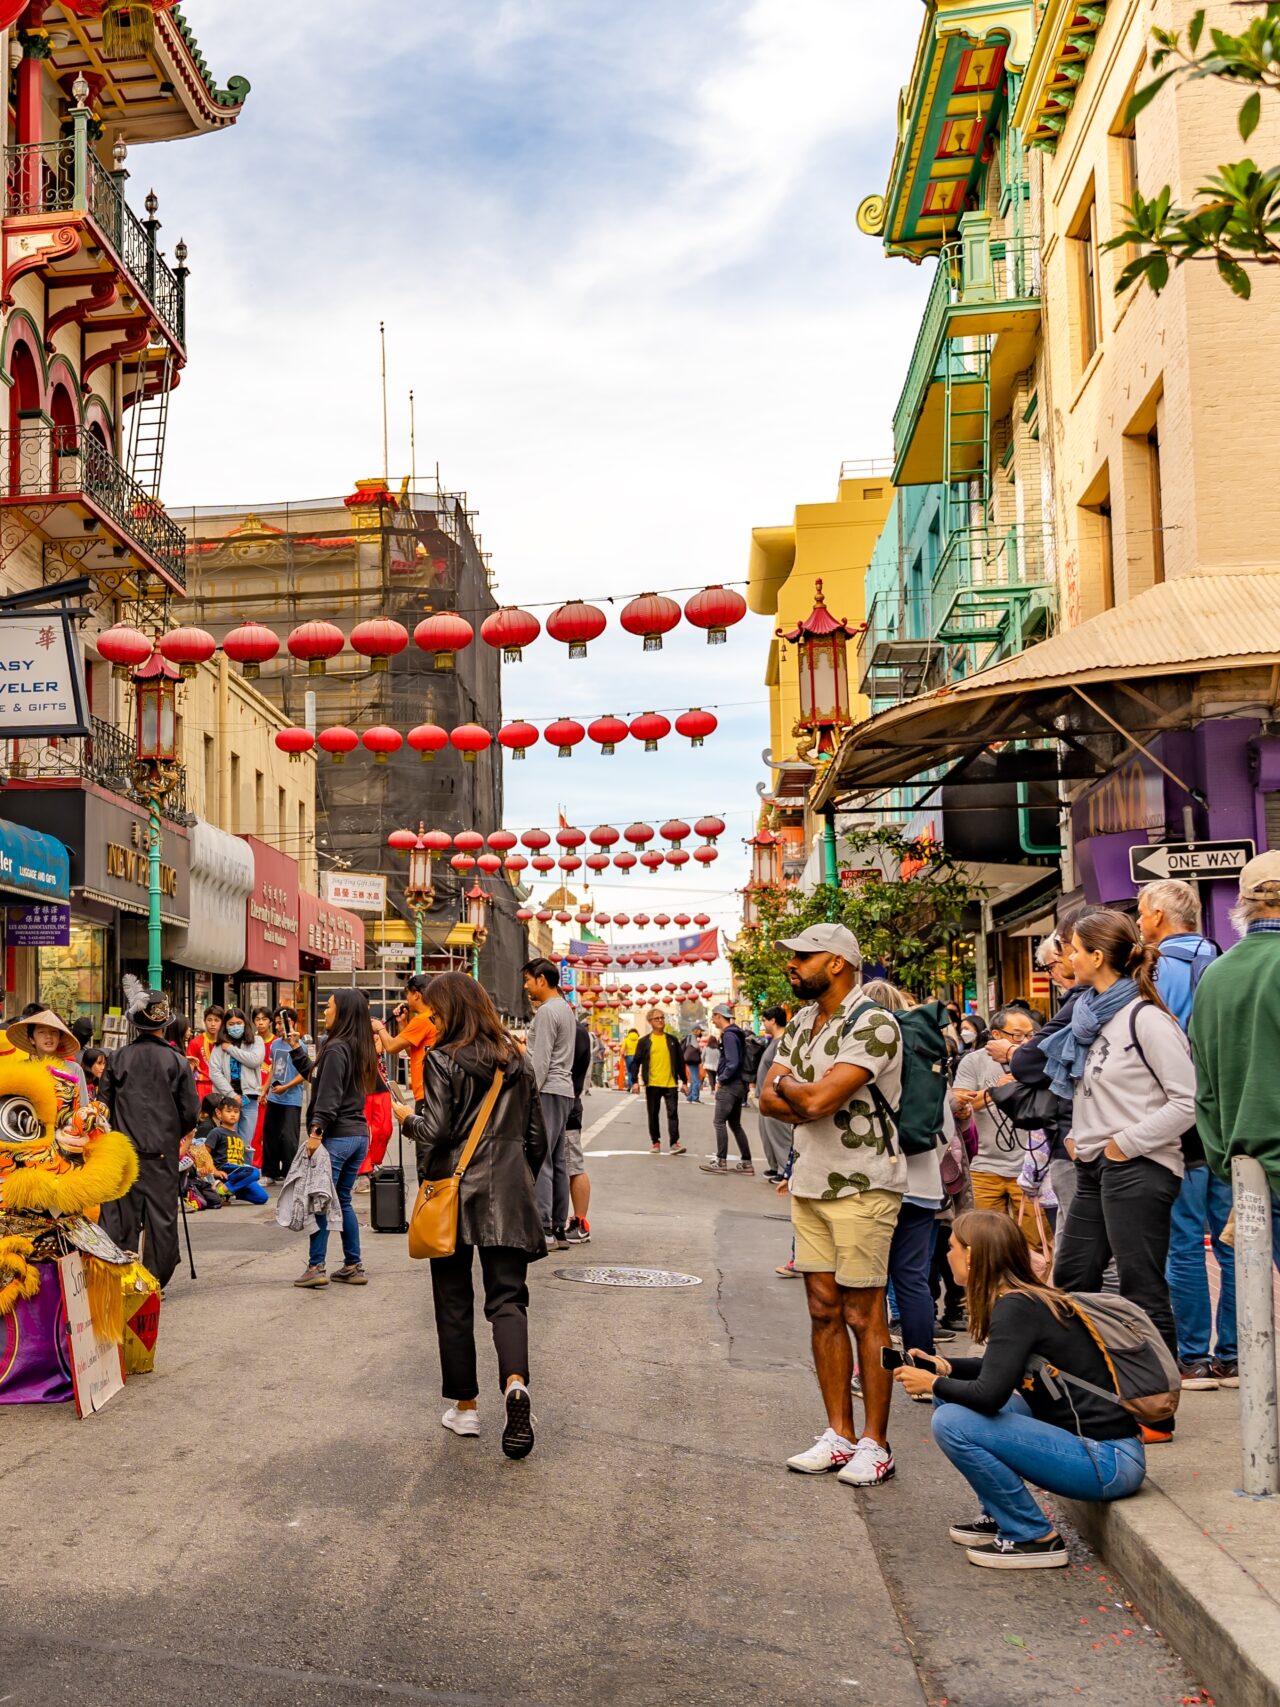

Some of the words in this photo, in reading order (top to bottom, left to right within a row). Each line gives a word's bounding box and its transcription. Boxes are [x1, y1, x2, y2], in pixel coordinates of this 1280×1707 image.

[35, 624, 57, 651] 華
[13, 703, 22, 712] &
[28, 702, 68, 711] GIFTS
[107, 841, 137, 882] NEW
[1168, 854, 1200, 869] ONE
[1206, 852, 1240, 867] WAY
